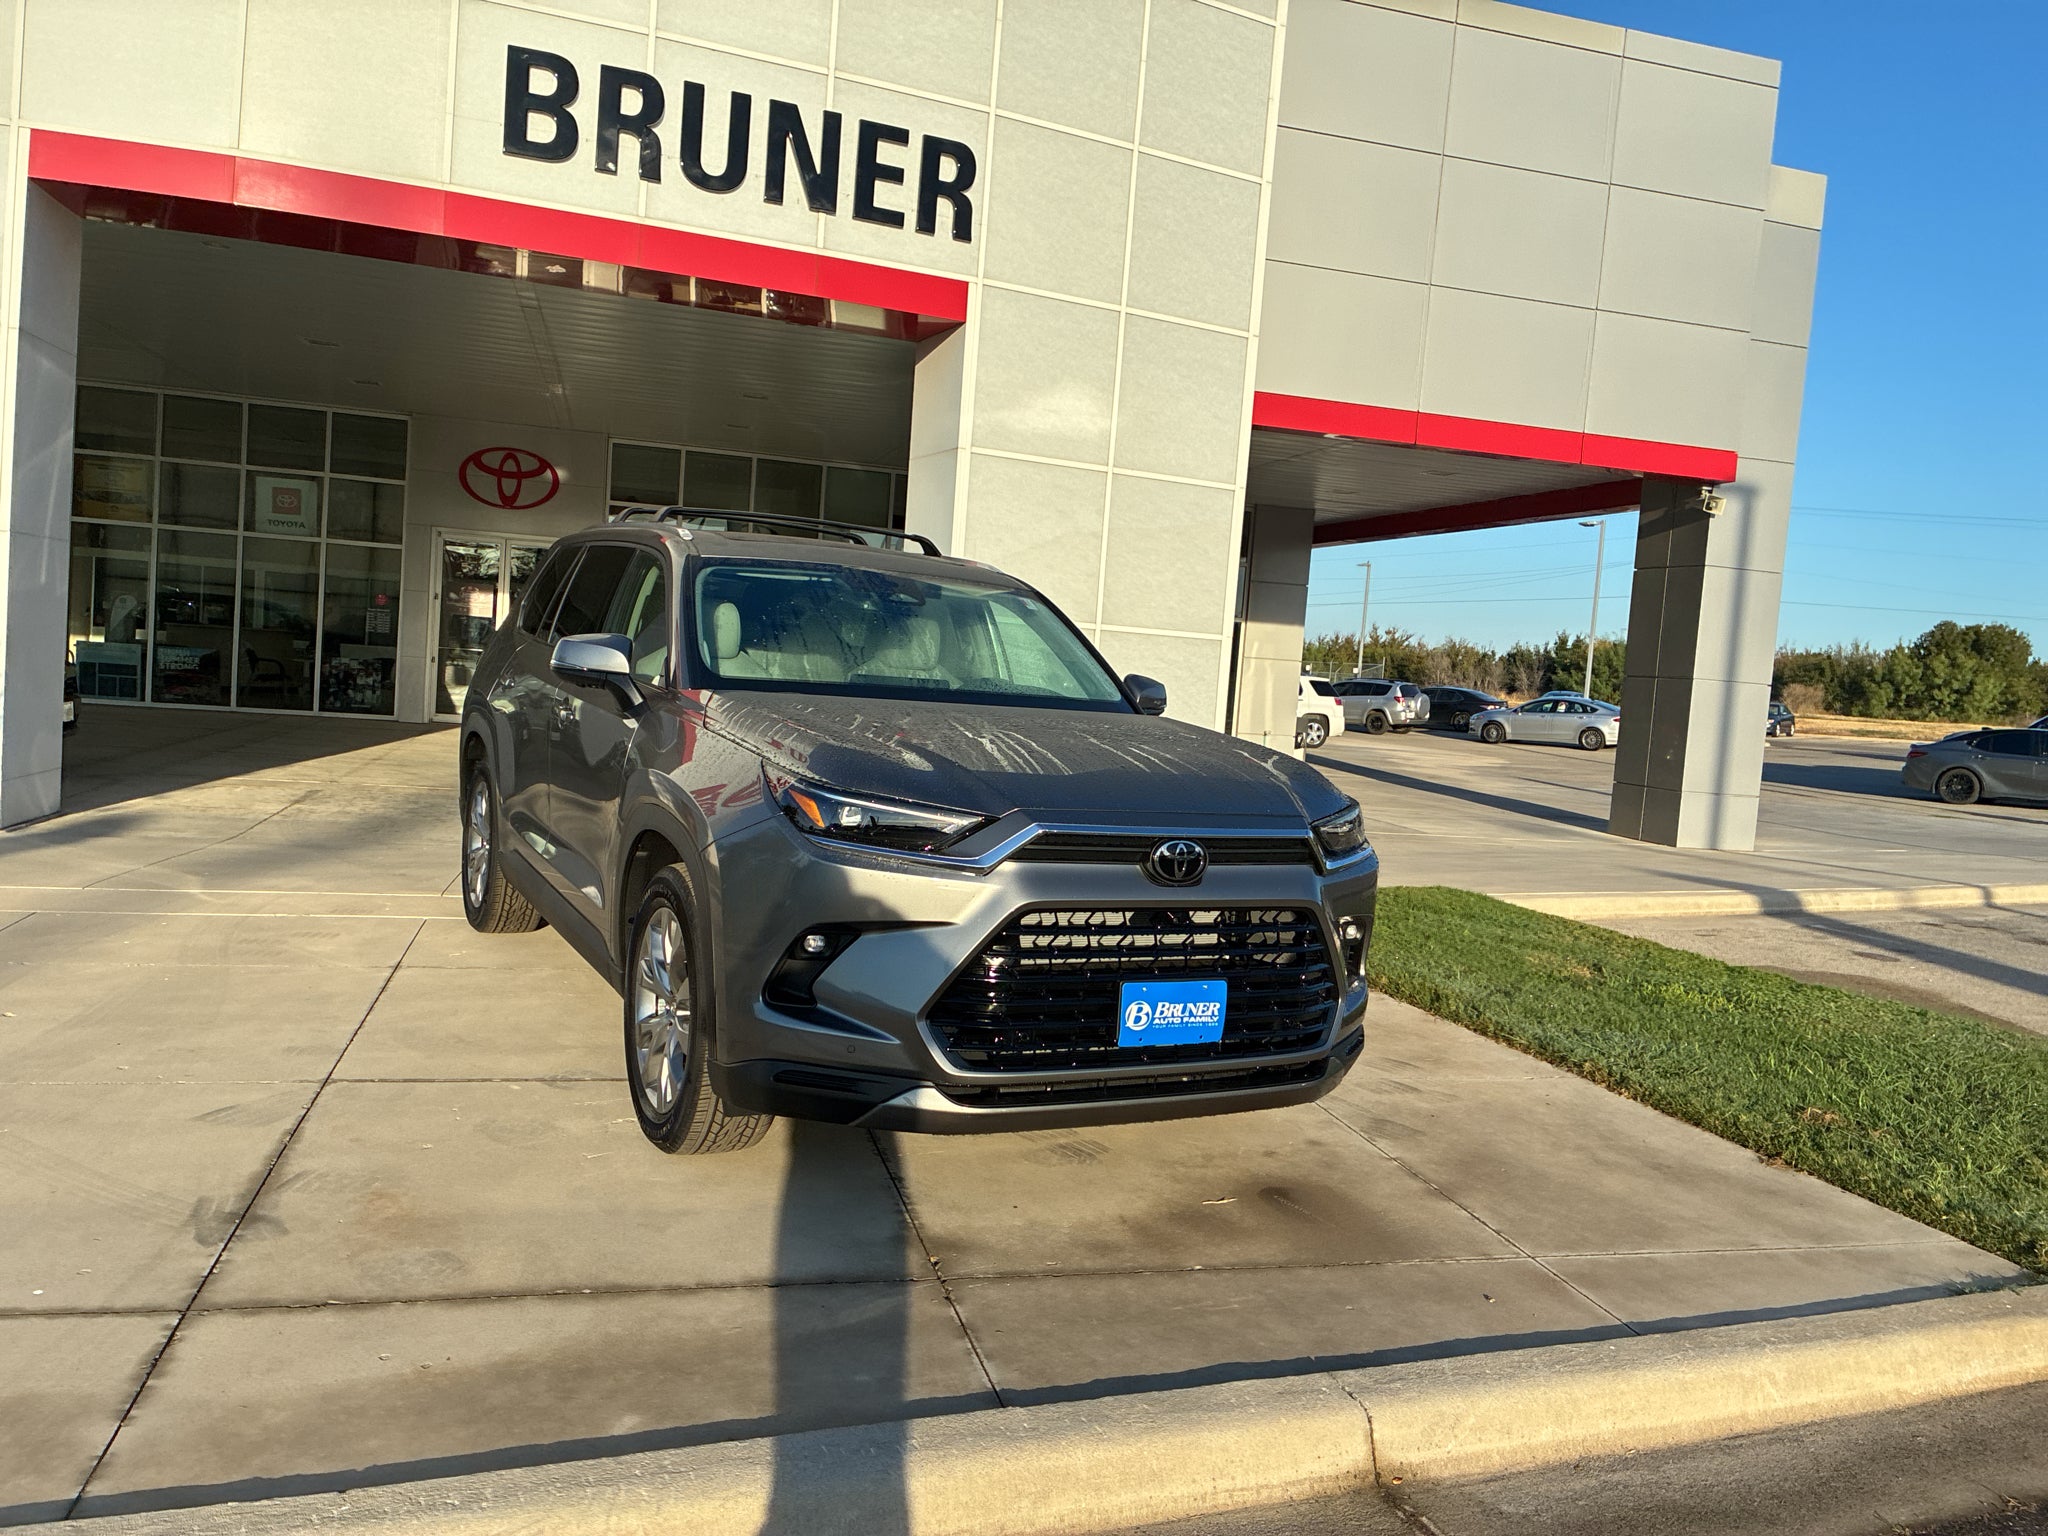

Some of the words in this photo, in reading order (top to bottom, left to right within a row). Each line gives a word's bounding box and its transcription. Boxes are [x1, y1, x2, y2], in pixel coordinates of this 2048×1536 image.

[502, 44, 977, 243] BRUNER
[266, 519, 306, 529] TOYOTA
[1153, 1001, 1220, 1018] BRUNER
[1183, 1015, 1219, 1023] FAMILY
